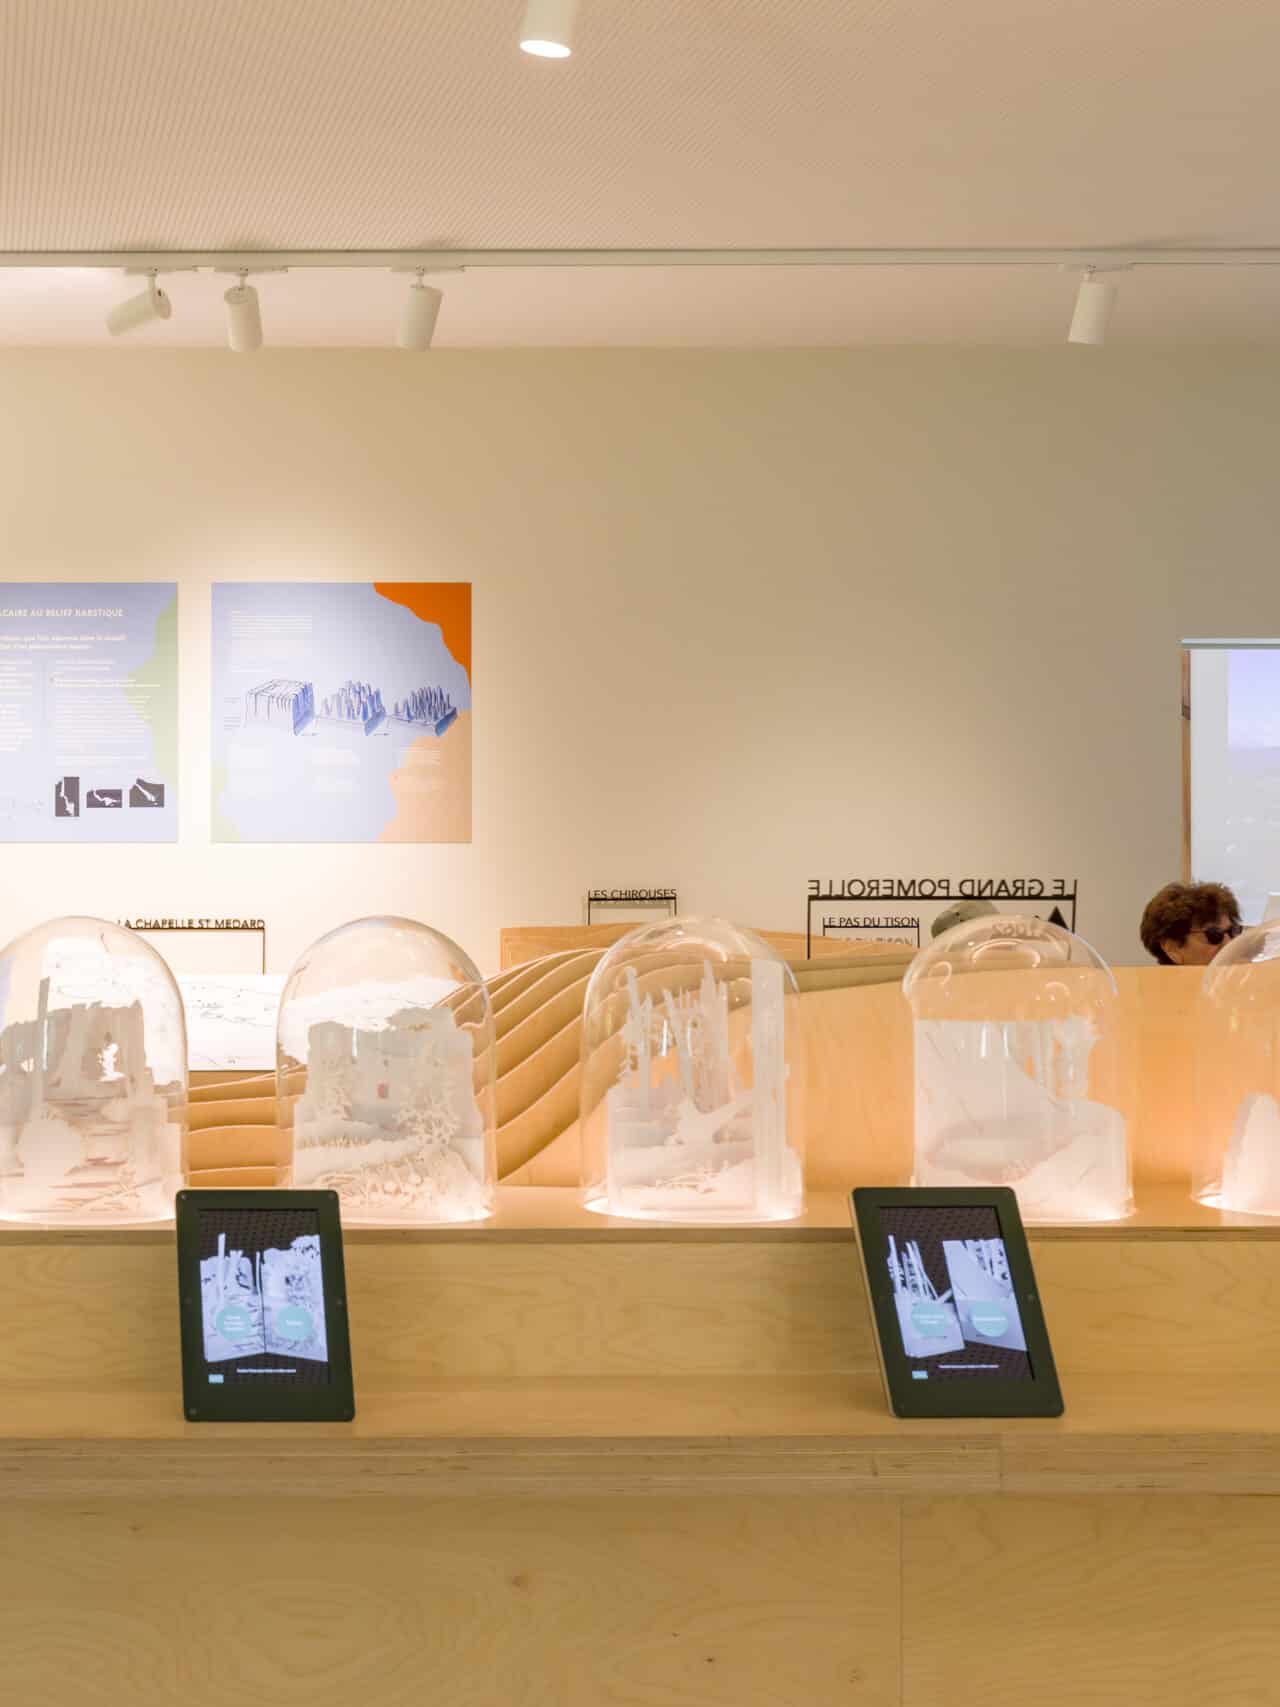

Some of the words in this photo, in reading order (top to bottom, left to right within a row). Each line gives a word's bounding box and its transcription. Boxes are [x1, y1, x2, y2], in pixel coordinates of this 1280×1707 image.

[588, 889, 607, 899] LES
[610, 888, 677, 899] CHIROUSES
[135, 919, 193, 929] CHAPELLE
[198, 919, 210, 929] ST
[215, 919, 265, 929] MEDARD
[823, 917, 837, 927] LE
[839, 917, 860, 927] PAS
[863, 917, 880, 927] DU
[883, 917, 920, 927] TISON
